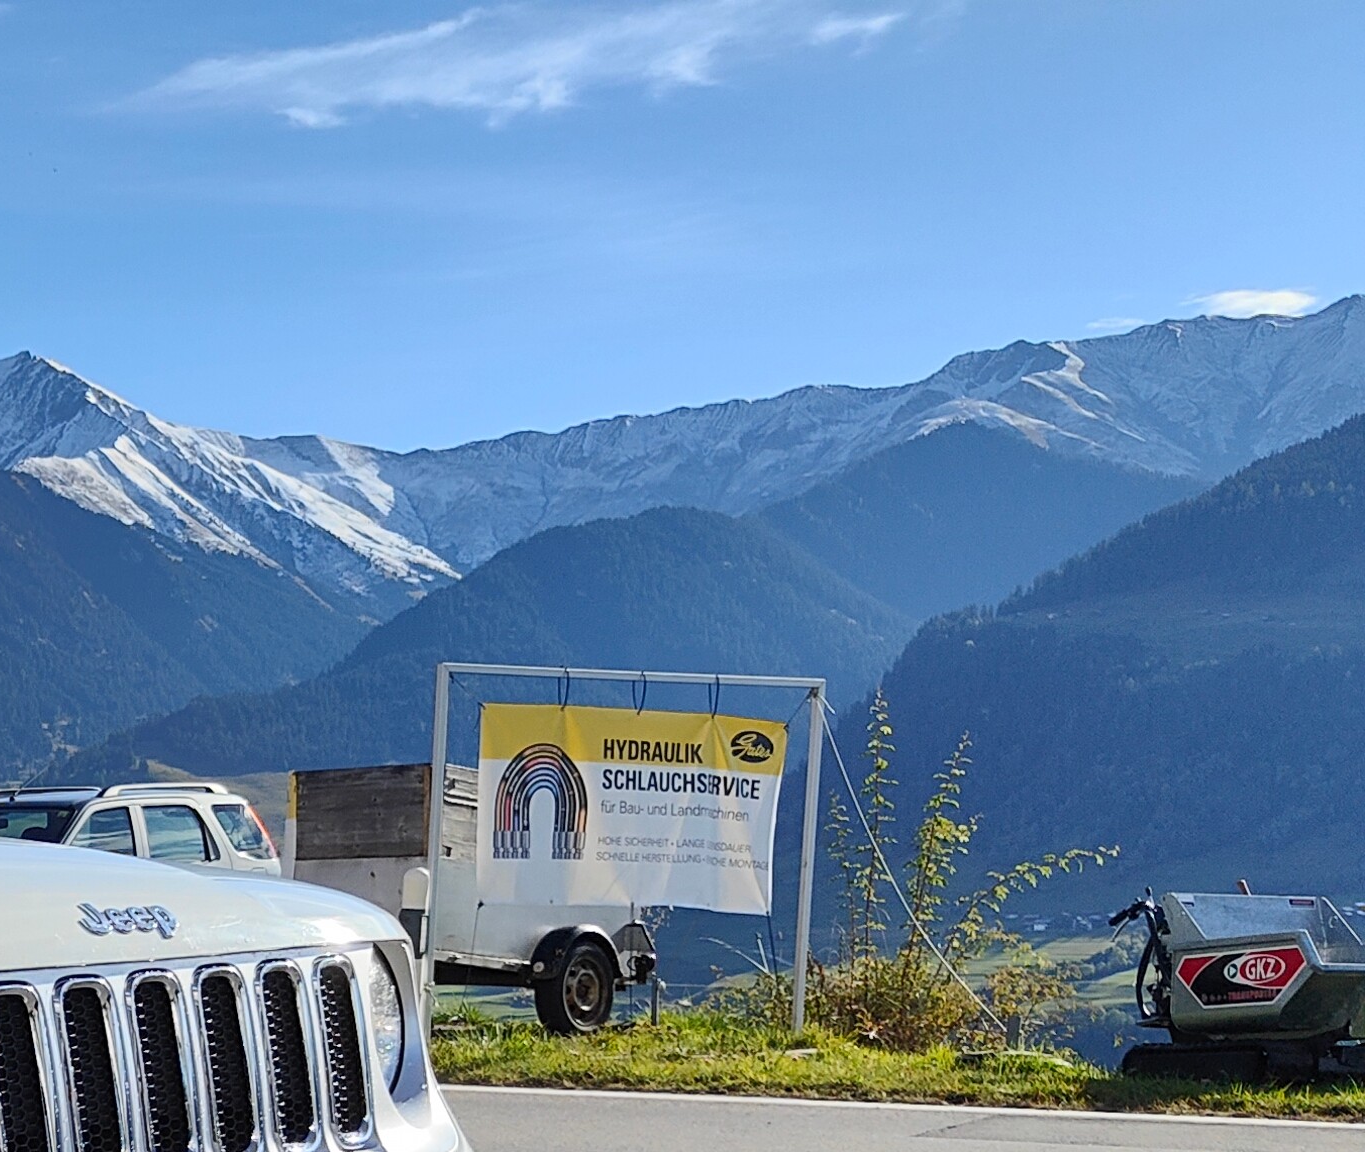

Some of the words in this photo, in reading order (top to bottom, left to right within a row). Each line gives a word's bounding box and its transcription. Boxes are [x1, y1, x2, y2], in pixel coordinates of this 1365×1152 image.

[603, 738, 704, 764] HYDRAULIK
[601, 768, 761, 800] SCHLAUCHSERVICE
[600, 799, 616, 815] für
[619, 800, 644, 815] Bau-
[647, 801, 668, 817] und
[597, 836, 622, 847] HOHE
[624, 837, 669, 849] SICHERHEIT
[676, 839, 706, 850] LANGE
[595, 851, 640, 863] SCHNELLE
[642, 852, 702, 864] HERSTELLUNG
[76, 902, 178, 939] Jeep
[1245, 957, 1276, 980] GKZ
